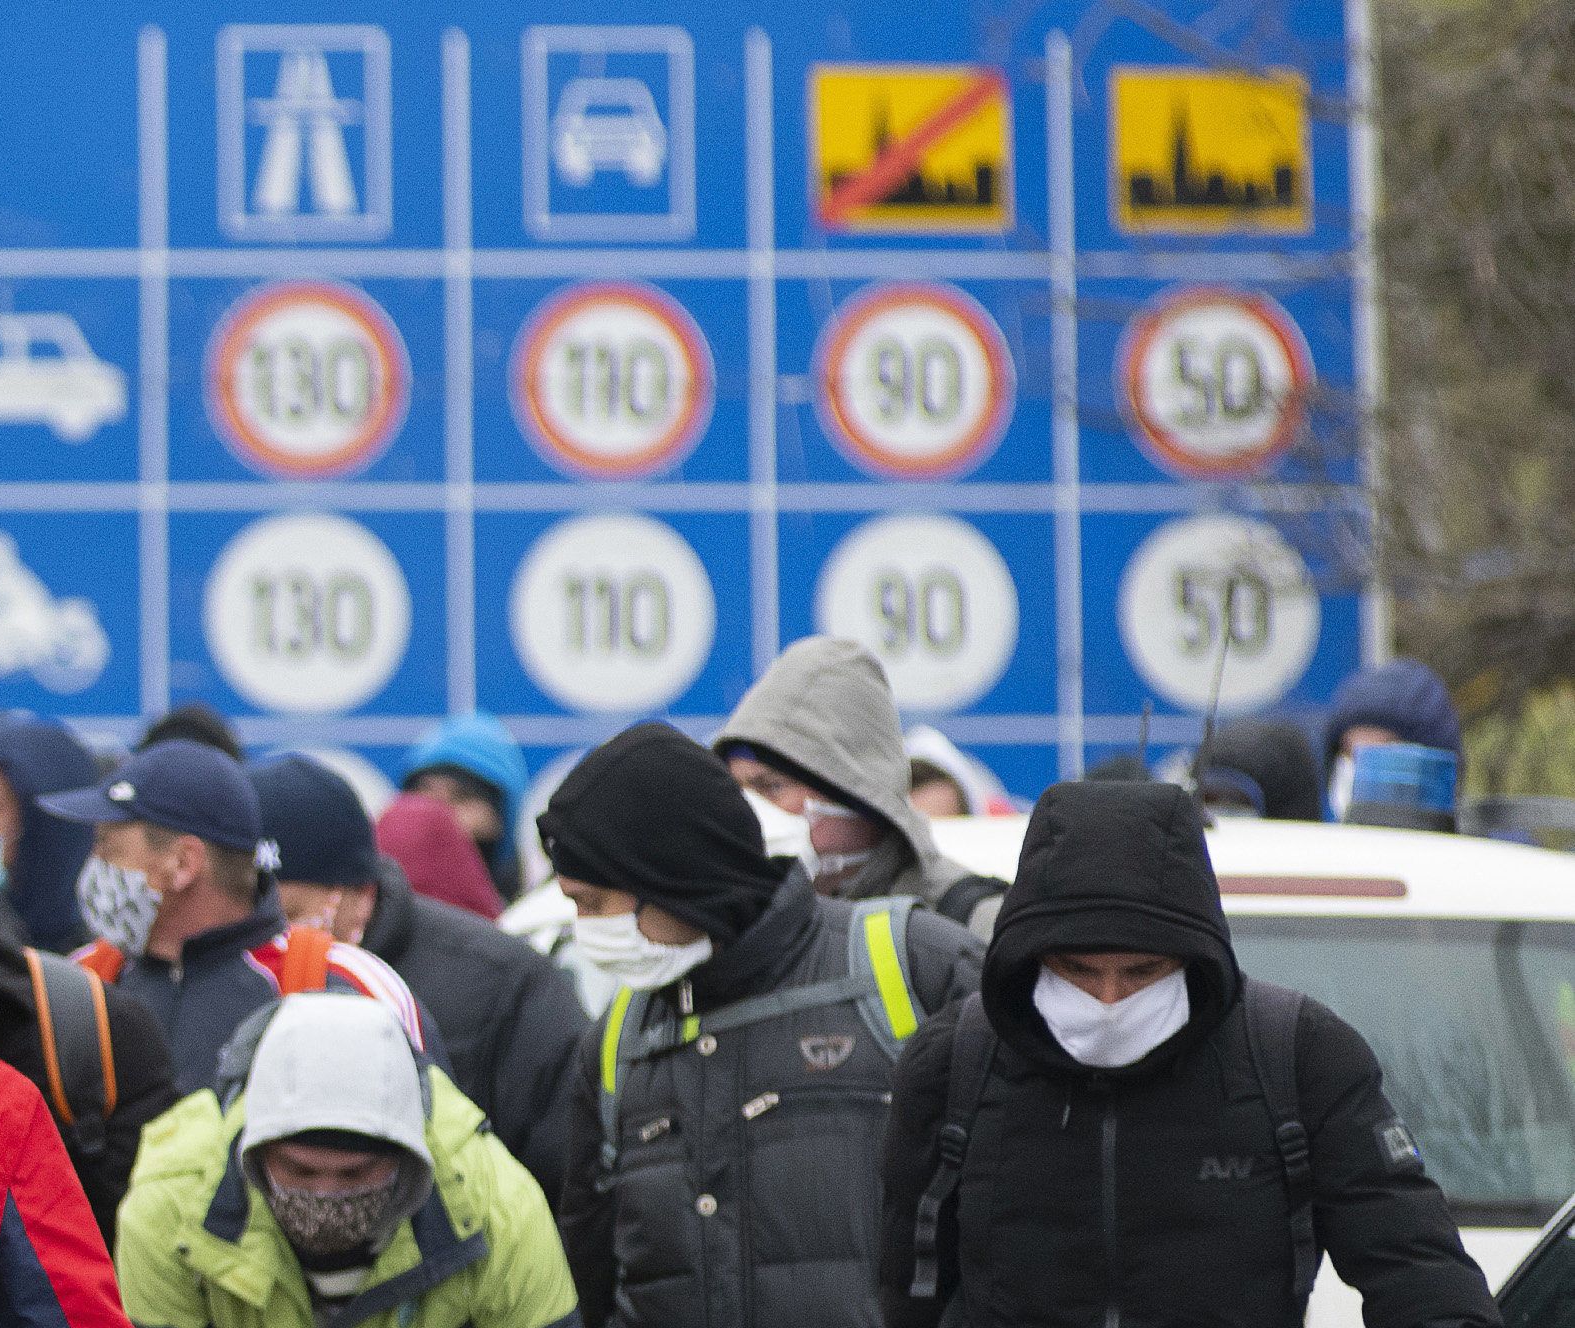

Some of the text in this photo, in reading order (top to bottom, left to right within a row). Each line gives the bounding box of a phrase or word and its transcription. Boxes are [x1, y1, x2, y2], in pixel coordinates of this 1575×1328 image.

[250, 334, 372, 428] 130
[562, 334, 670, 428] 110
[872, 334, 962, 428] 90
[1172, 334, 1262, 428] 50
[250, 568, 375, 664] 130
[562, 568, 670, 663] 110
[874, 568, 965, 662] 90
[1176, 566, 1272, 662] 50
